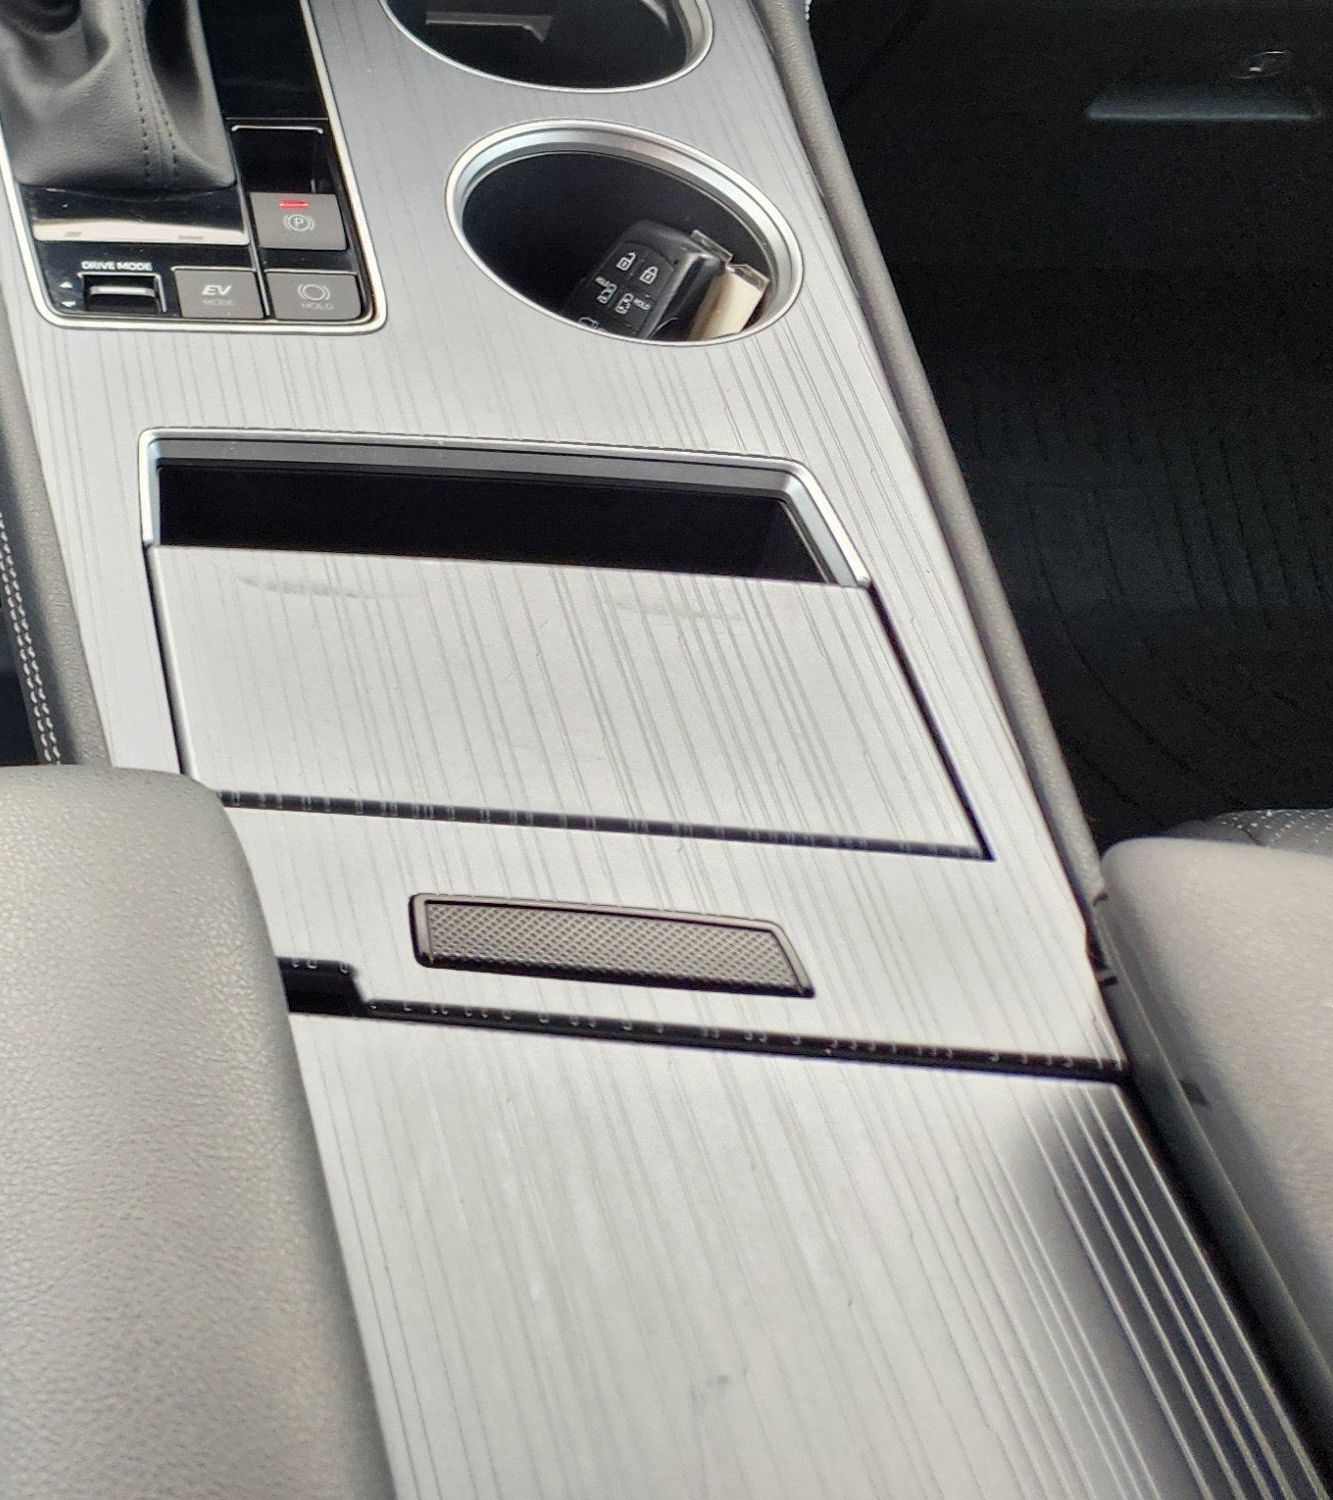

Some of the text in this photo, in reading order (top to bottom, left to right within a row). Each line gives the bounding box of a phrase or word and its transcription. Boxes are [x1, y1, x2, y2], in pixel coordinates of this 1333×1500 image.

[81, 260, 154, 272] DRIVE MODE
[201, 284, 233, 296] EV
